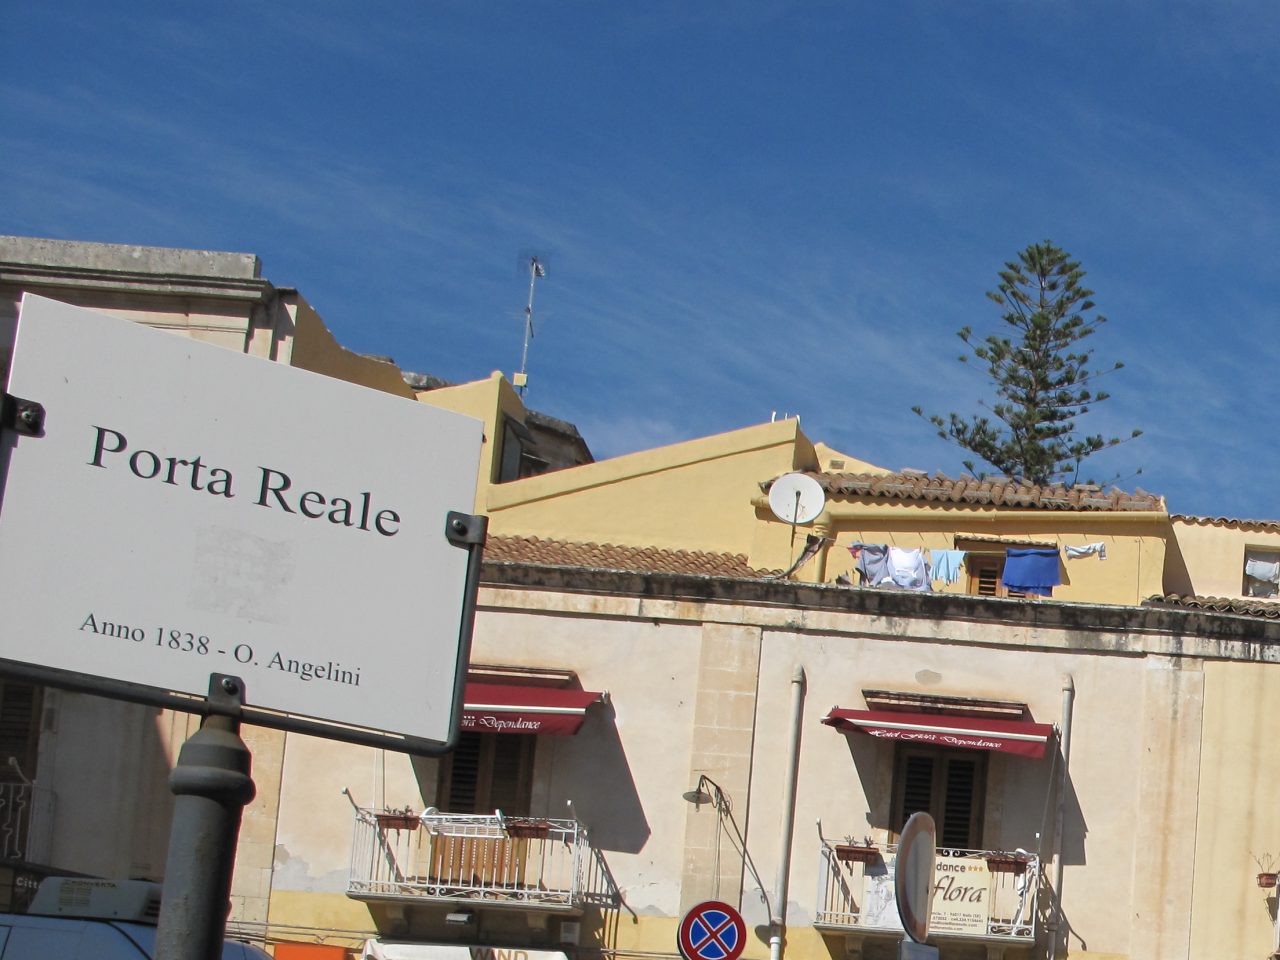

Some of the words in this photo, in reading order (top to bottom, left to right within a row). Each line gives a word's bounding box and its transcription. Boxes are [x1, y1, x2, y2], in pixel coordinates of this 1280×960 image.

[86, 424, 236, 499] Porta
[252, 466, 401, 537] Reale
[79, 612, 145, 643] Anno
[155, 627, 210, 656] 1838
[233, 643, 259, 667] O.
[267, 651, 361, 687] Angelini
[935, 861, 966, 873] dance
